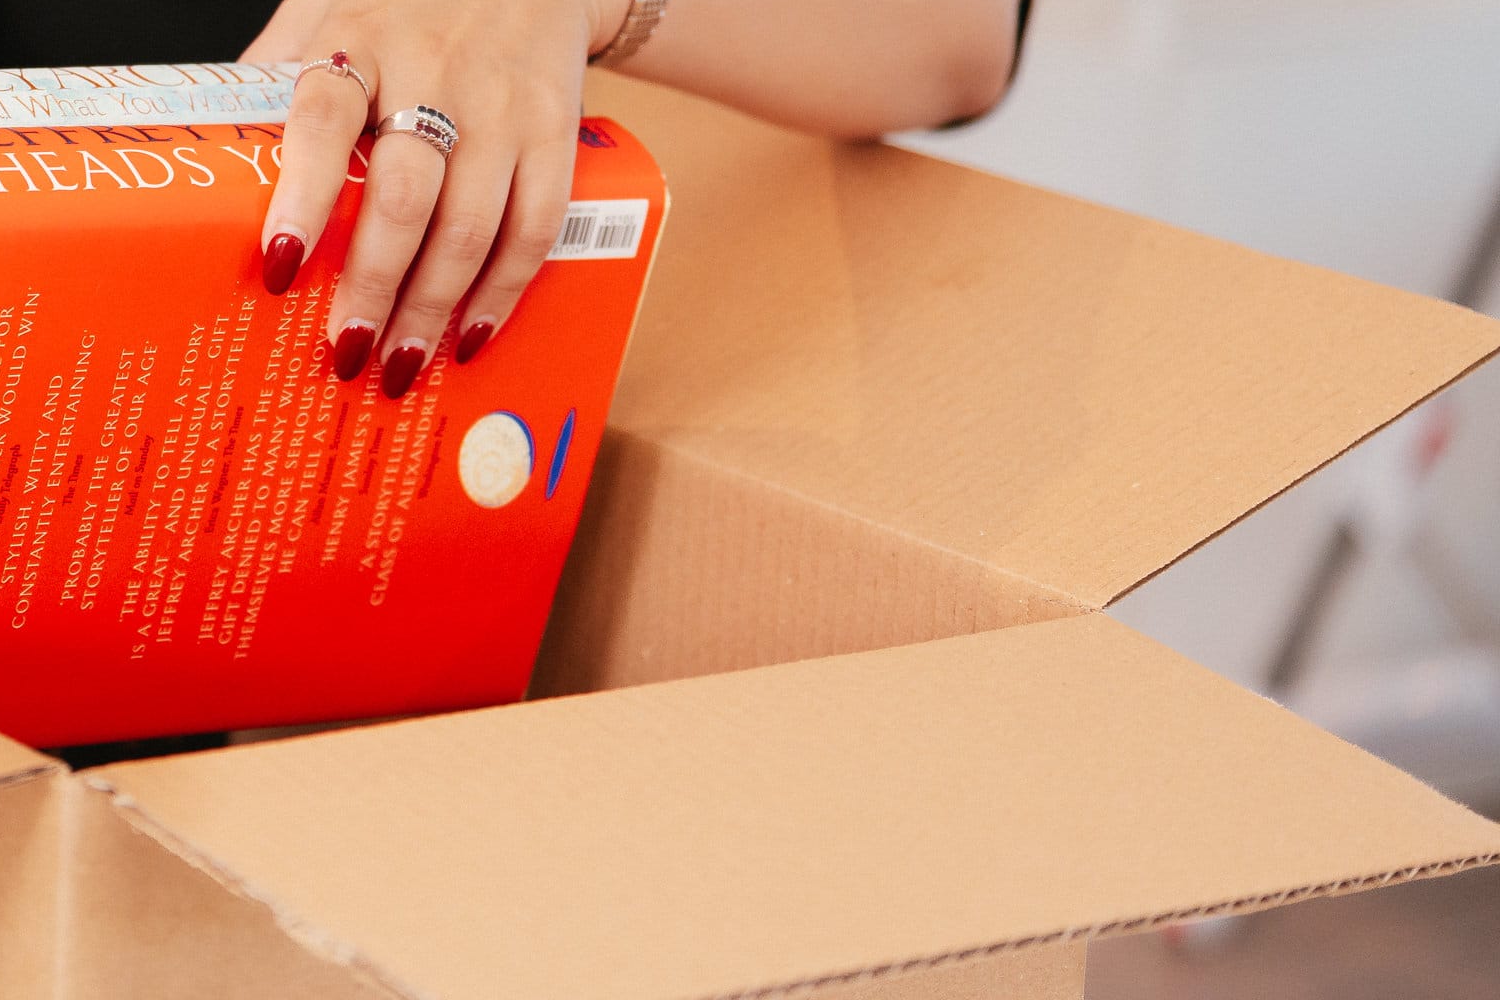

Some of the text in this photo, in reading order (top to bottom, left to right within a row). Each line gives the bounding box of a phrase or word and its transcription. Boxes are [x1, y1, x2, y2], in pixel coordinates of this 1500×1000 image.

[14, 93, 106, 118] What
[108, 91, 174, 116] You
[175, 87, 256, 112] Wish
[177, 322, 205, 386] STORY
[207, 313, 229, 359] GIFT
[87, 455, 109, 493] THE
[99, 348, 135, 447] GREATEST
[123, 391, 146, 438] OUR
[173, 393, 188, 407] A
[219, 478, 252, 558] ARCHER
[241, 432, 262, 471] HAS
[252, 389, 273, 426] THE
[264, 292, 299, 381] STRANGE
[229, 405, 243, 436] Times
[22, 428, 50, 494] WITTY
[41, 374, 63, 421] AND
[115, 446, 132, 472] OF
[160, 414, 183, 457] TELL
[176, 381, 212, 479] UNUSUAL
[205, 437, 220, 451] A
[224, 438, 235, 457] The
[369, 426, 383, 454] Times
[1, 443, 21, 493] Telegraph
[62, 453, 82, 506] The Times
[124, 434, 153, 516] Mail on Sunday
[151, 463, 170, 492] TO
[198, 457, 215, 474] IS
[217, 285, 322, 645] GIFT DENIED TO MANY WHO THINK
[277, 364, 343, 573] HE CAN TELL A STOR
[366, 419, 411, 548] STORYTELLER
[399, 391, 417, 413] IN
[163, 487, 185, 533] AND
[177, 481, 209, 562] ARCHER
[234, 540, 278, 661] THEMSELVES
[267, 477, 294, 534] MORE
[284, 385, 316, 469] SERIOUS
[369, 546, 397, 606] CLASS
[387, 516, 405, 542] OF
[396, 395, 437, 509] ALEXANDRE
[11, 495, 56, 629] CONSTANTLY
[80, 479, 125, 610] STORYTELLER
[132, 498, 161, 573] ABILITY
[142, 554, 169, 617] GREAT
[155, 568, 186, 642] JEFFREY
[130, 643, 146, 659] IS
[136, 623, 151, 637] A
